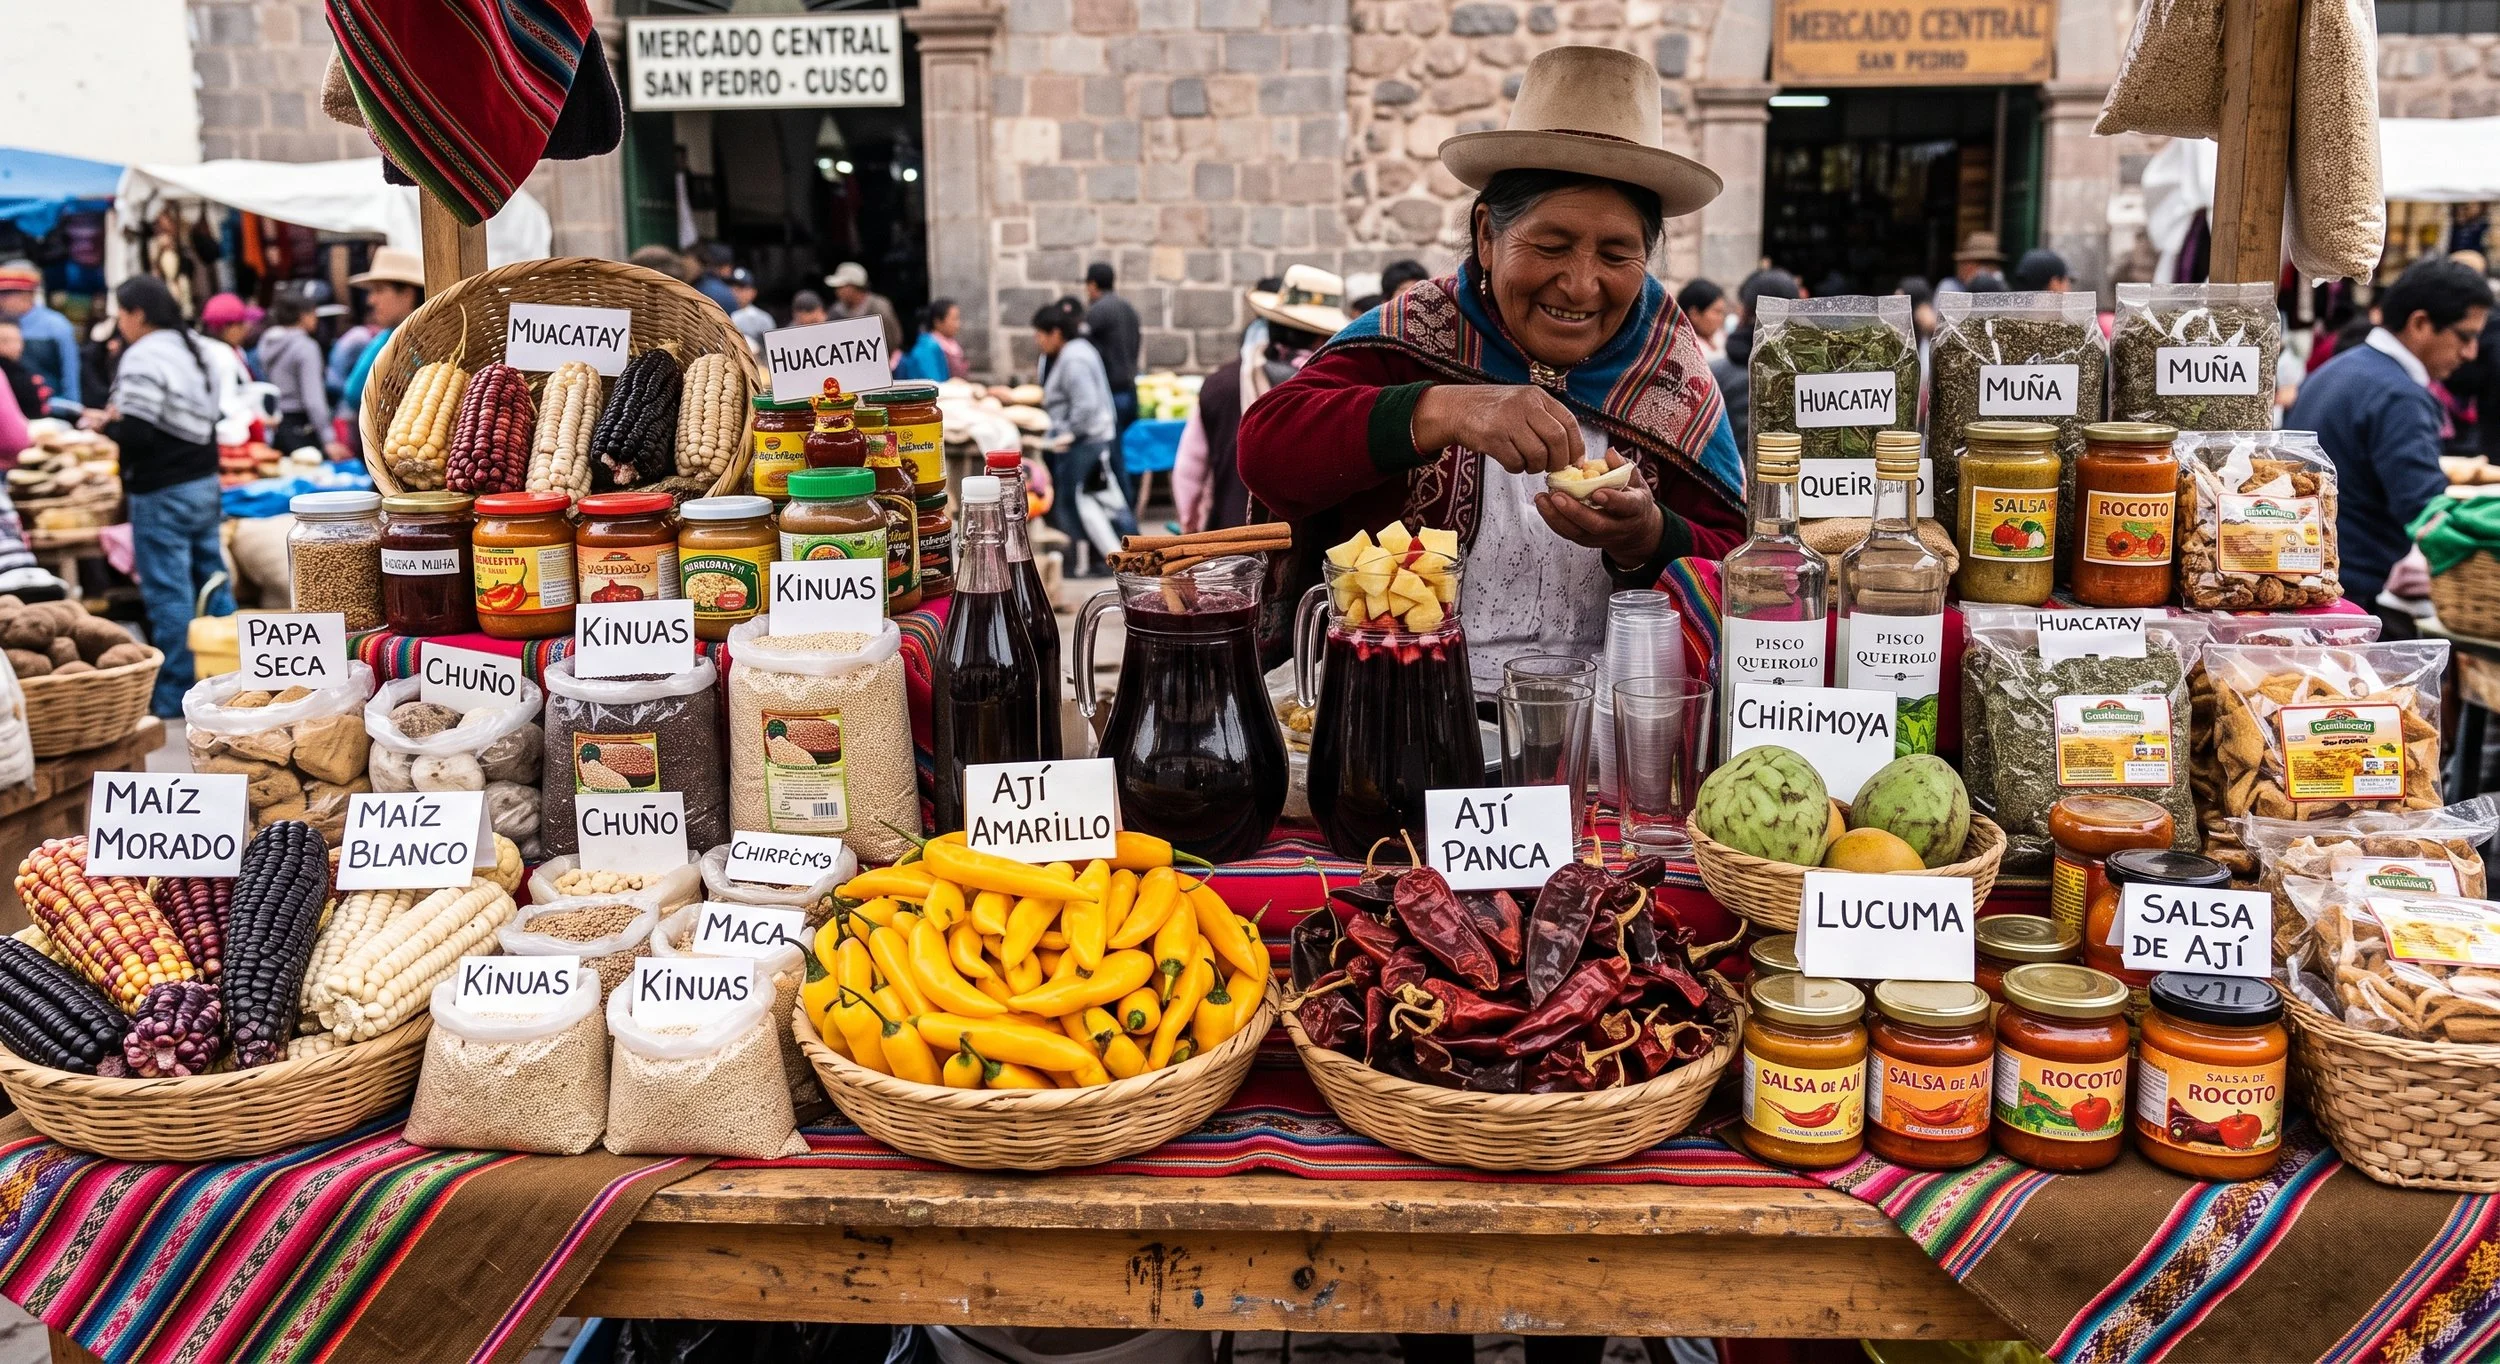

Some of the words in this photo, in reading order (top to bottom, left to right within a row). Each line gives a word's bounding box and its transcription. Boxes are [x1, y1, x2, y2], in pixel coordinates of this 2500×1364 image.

[1789, 9, 1911, 41] MERCADO
[1920, 7, 2040, 41] CENTRAL
[638, 28, 762, 58] MERCADO
[772, 26, 890, 56] CENTRAL
[1857, 51, 1895, 70] SAN
[1906, 50, 1967, 70] PEDRO
[645, 71, 692, 98] SAN
[702, 68, 781, 96] PEDRO
[805, 66, 887, 94] CUSCO
[512, 318, 626, 353] MUACATAY
[771, 336, 881, 374] HUACATAY
[2169, 354, 2247, 385] MUÑA
[1799, 387, 1893, 413] HUACATAY
[1986, 373, 2062, 402] MUÑA
[1993, 498, 2047, 514] SALSA
[2099, 500, 2170, 517] ROCOTO
[248, 618, 321, 647] PAPA
[2039, 613, 2142, 633] HUACATAY
[1755, 638, 1804, 650] PISCO
[1876, 633, 1924, 646] PISCO
[253, 654, 326, 679] SECA
[1737, 655, 1818, 673] QUEIROLO
[1856, 650, 1937, 668] QUEIROLO
[425, 657, 516, 697] CHUÑO
[105, 778, 201, 815] MAÍZ
[992, 764, 1052, 810] AJÍ
[358, 796, 442, 829] MAÍZ
[582, 805, 679, 836] CHUÑO
[1454, 793, 1514, 835] AJÍ
[95, 827, 236, 861] MORADO
[348, 839, 468, 869] BLANCO
[1441, 839, 1551, 873] PANCA
[1817, 891, 1965, 933] LUCUMA
[2140, 893, 2254, 930] SALSA
[703, 912, 786, 946] MACA
[2132, 934, 2169, 959] DE
[2184, 934, 2249, 970] AJÍ
[1761, 1068, 1817, 1094] SALSA
[1889, 1066, 1946, 1092] SALSA
[1950, 1078, 1966, 1091] DE
[2040, 1068, 2123, 1090] ROCOTO
[2206, 1072, 2249, 1084] SALSA
[2252, 1072, 2266, 1083] DE
[2187, 1083, 2276, 1106] ROCOTO
